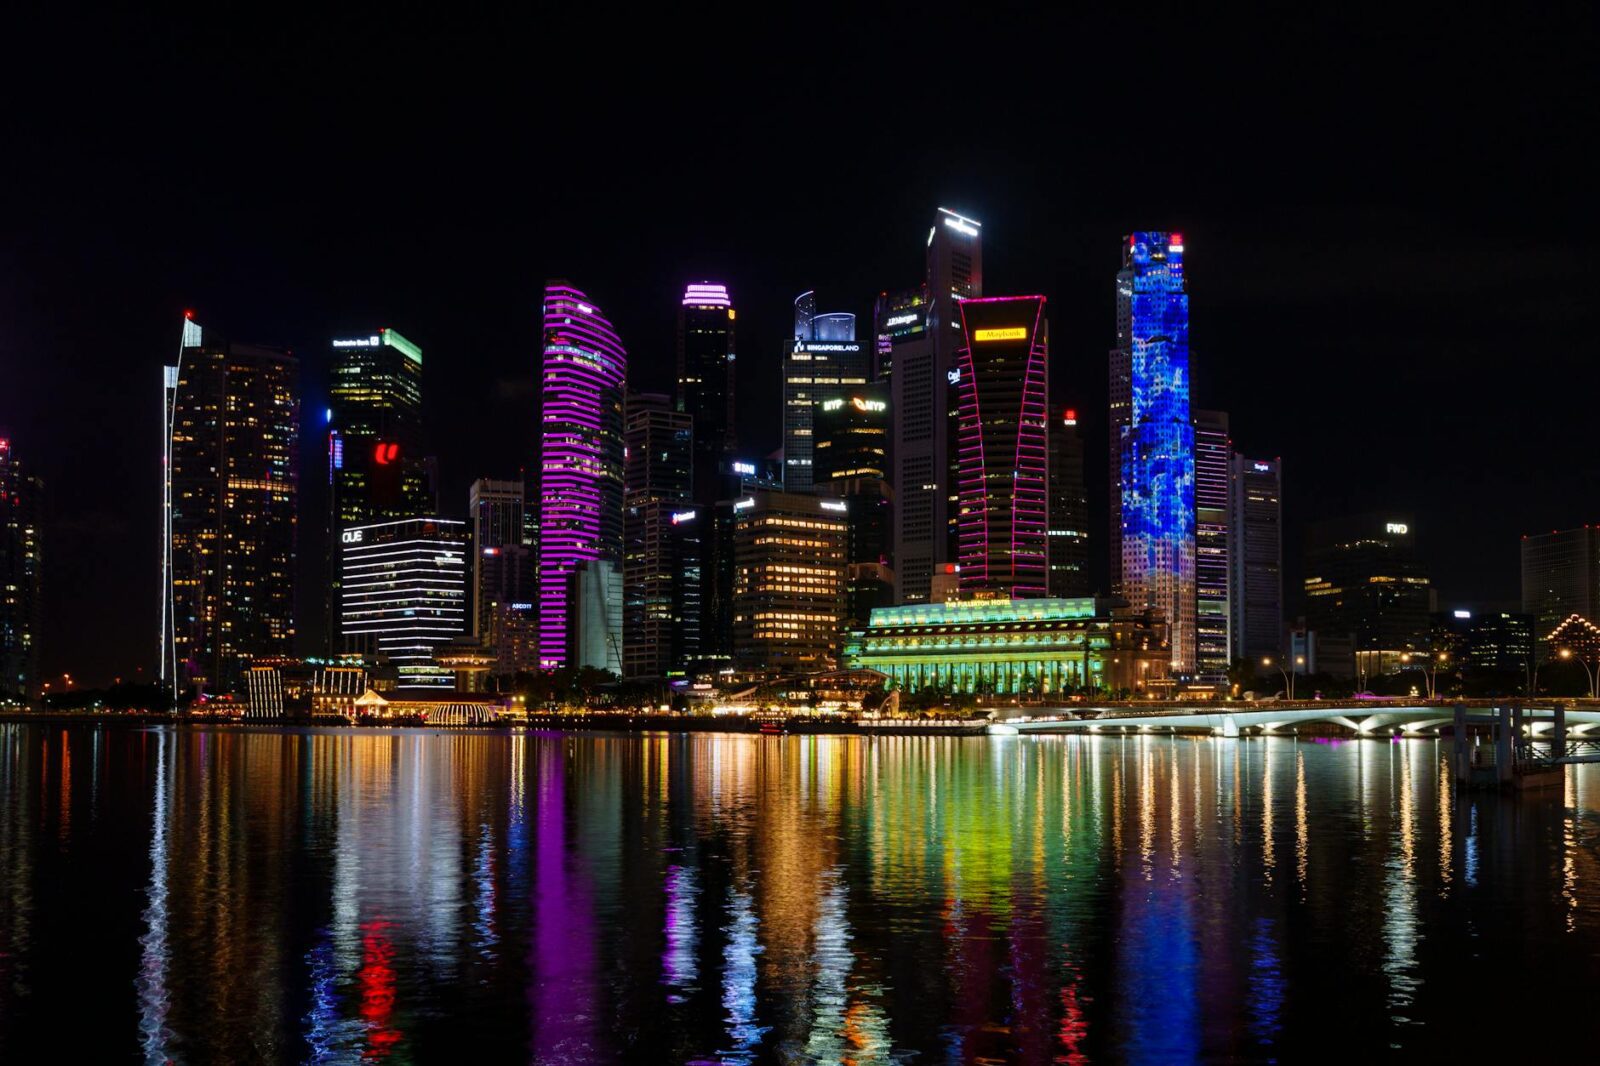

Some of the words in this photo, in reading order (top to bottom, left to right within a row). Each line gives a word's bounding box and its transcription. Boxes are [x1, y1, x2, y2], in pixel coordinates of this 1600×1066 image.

[986, 329, 1021, 338] Maybank
[823, 399, 842, 411] MYP
[865, 400, 886, 411] MYP
[1387, 523, 1408, 534] FWD
[342, 530, 363, 543] OUE
